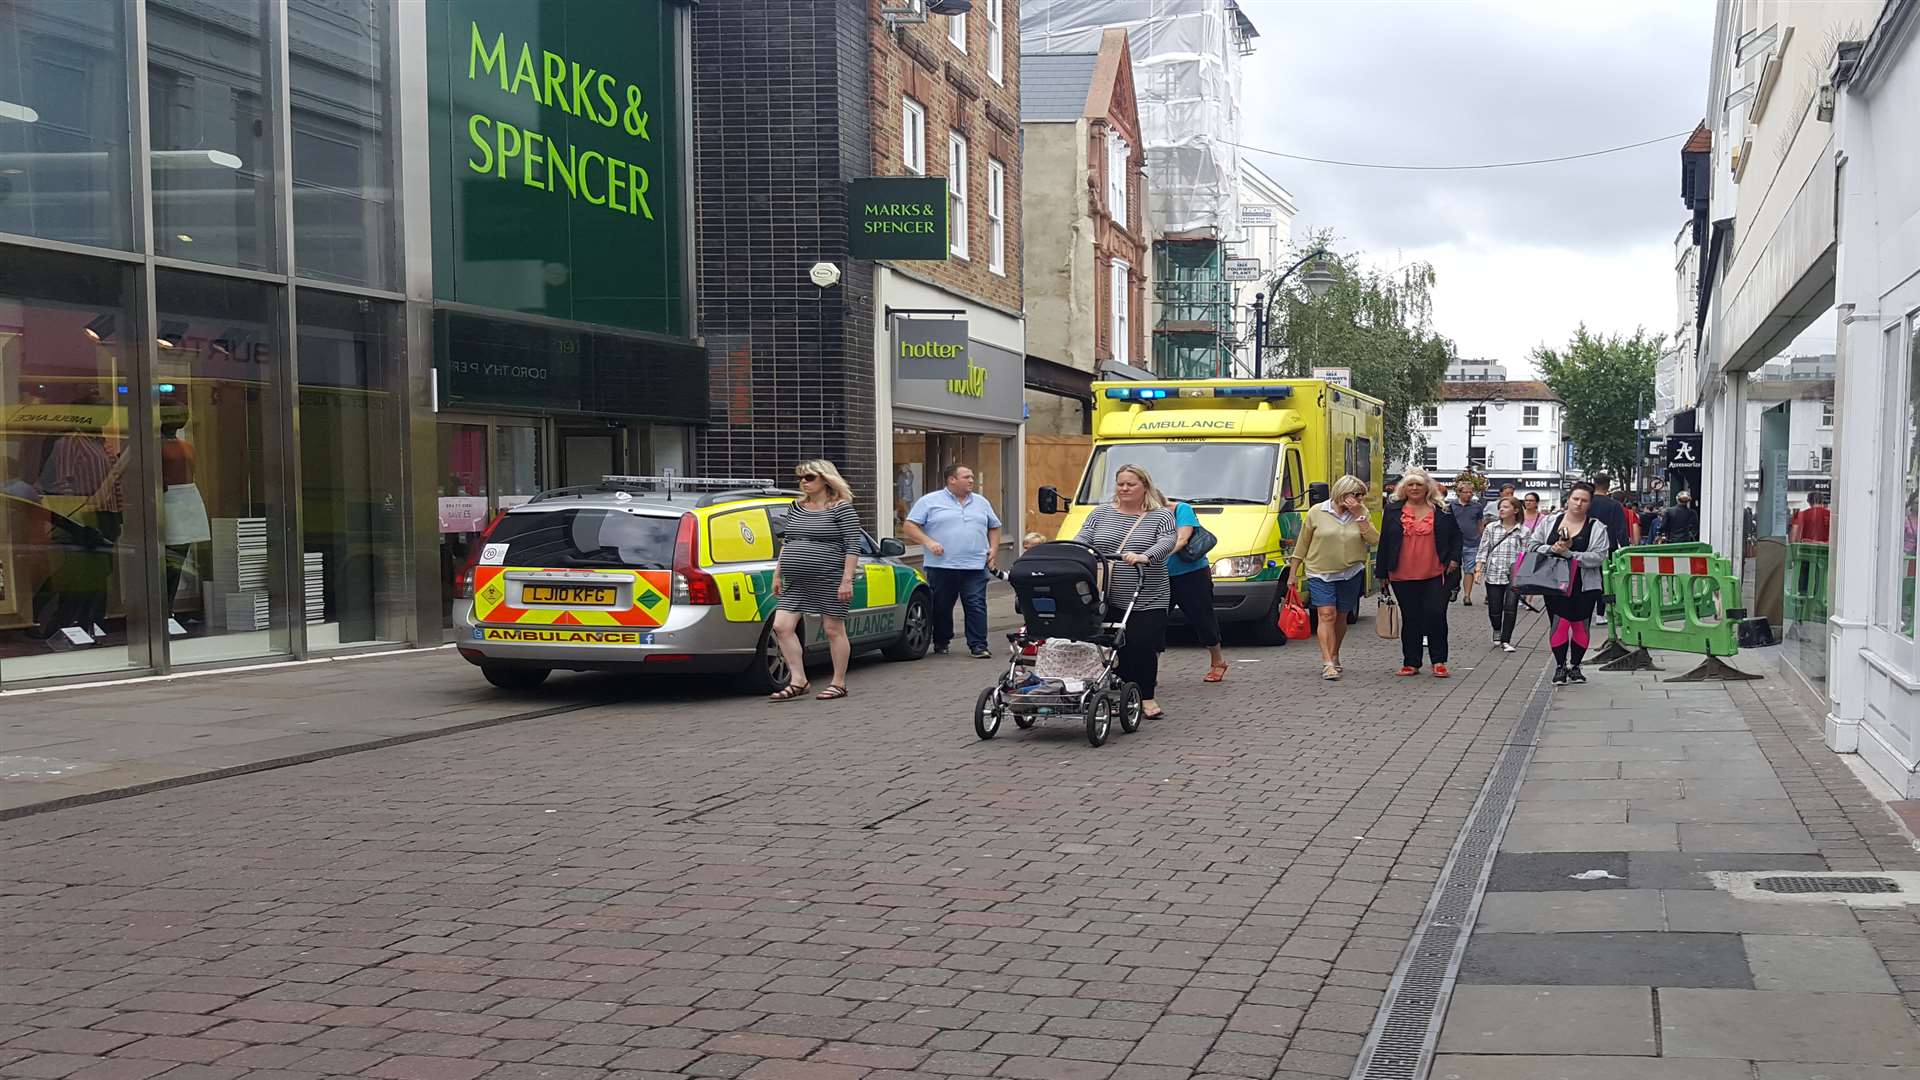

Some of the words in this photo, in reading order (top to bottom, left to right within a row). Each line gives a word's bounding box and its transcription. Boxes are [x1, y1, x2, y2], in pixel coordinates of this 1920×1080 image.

[469, 20, 619, 128] MARKS
[623, 83, 651, 142] &
[468, 113, 654, 221] SPENCER
[864, 203, 920, 217] MARKS
[923, 203, 934, 217] &
[864, 220, 935, 235] SPENCER
[901, 341, 963, 359] hotter
[1137, 420, 1237, 431] AMBULANCE
[1525, 480, 1547, 488] LUSH
[533, 587, 569, 601] LJ10
[573, 588, 605, 602] KFG
[488, 629, 636, 644] AMBULANCE
